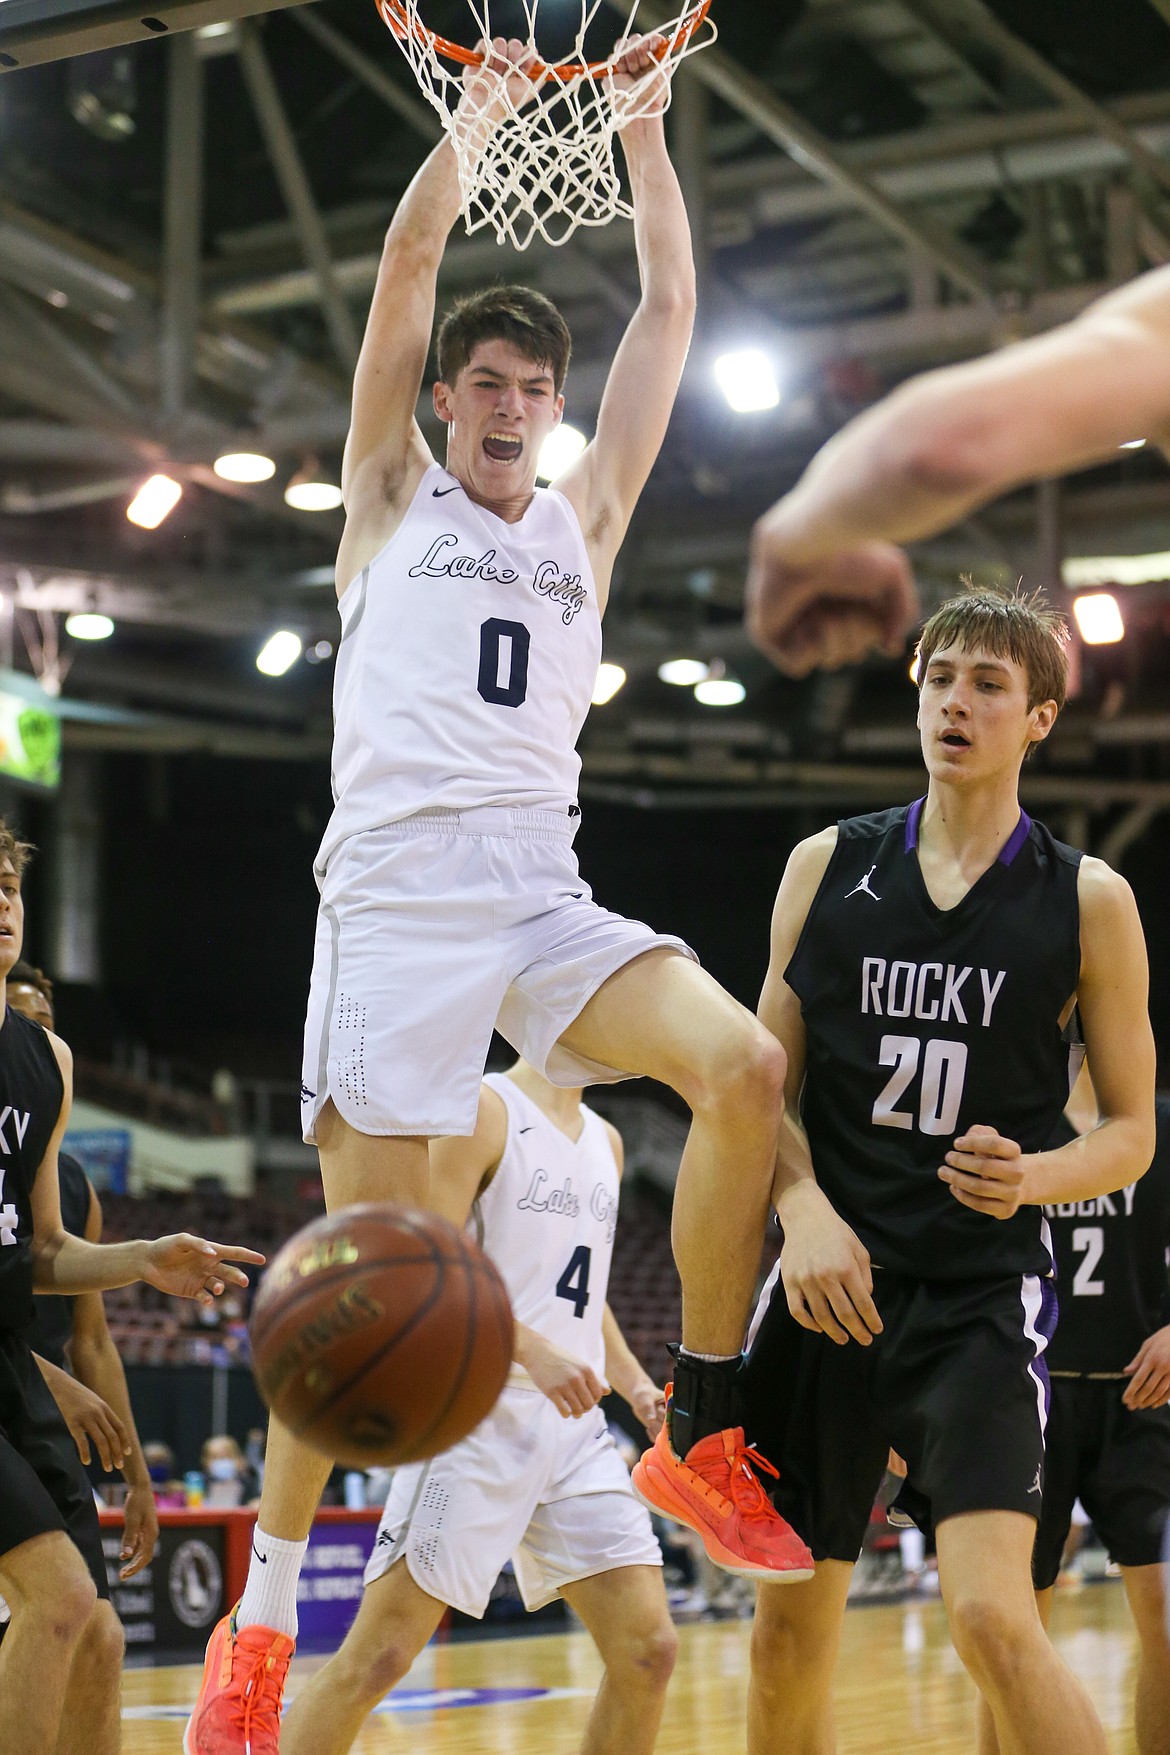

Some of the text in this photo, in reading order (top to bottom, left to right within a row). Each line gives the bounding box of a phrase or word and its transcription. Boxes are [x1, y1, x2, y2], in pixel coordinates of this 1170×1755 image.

[408, 534, 587, 625] Lake City
[477, 617, 531, 708] 0
[861, 956, 1007, 1027] ROCKY
[871, 1034, 968, 1136] 20
[555, 1245, 591, 1319] 4
[1072, 1227, 1105, 1296] 2
